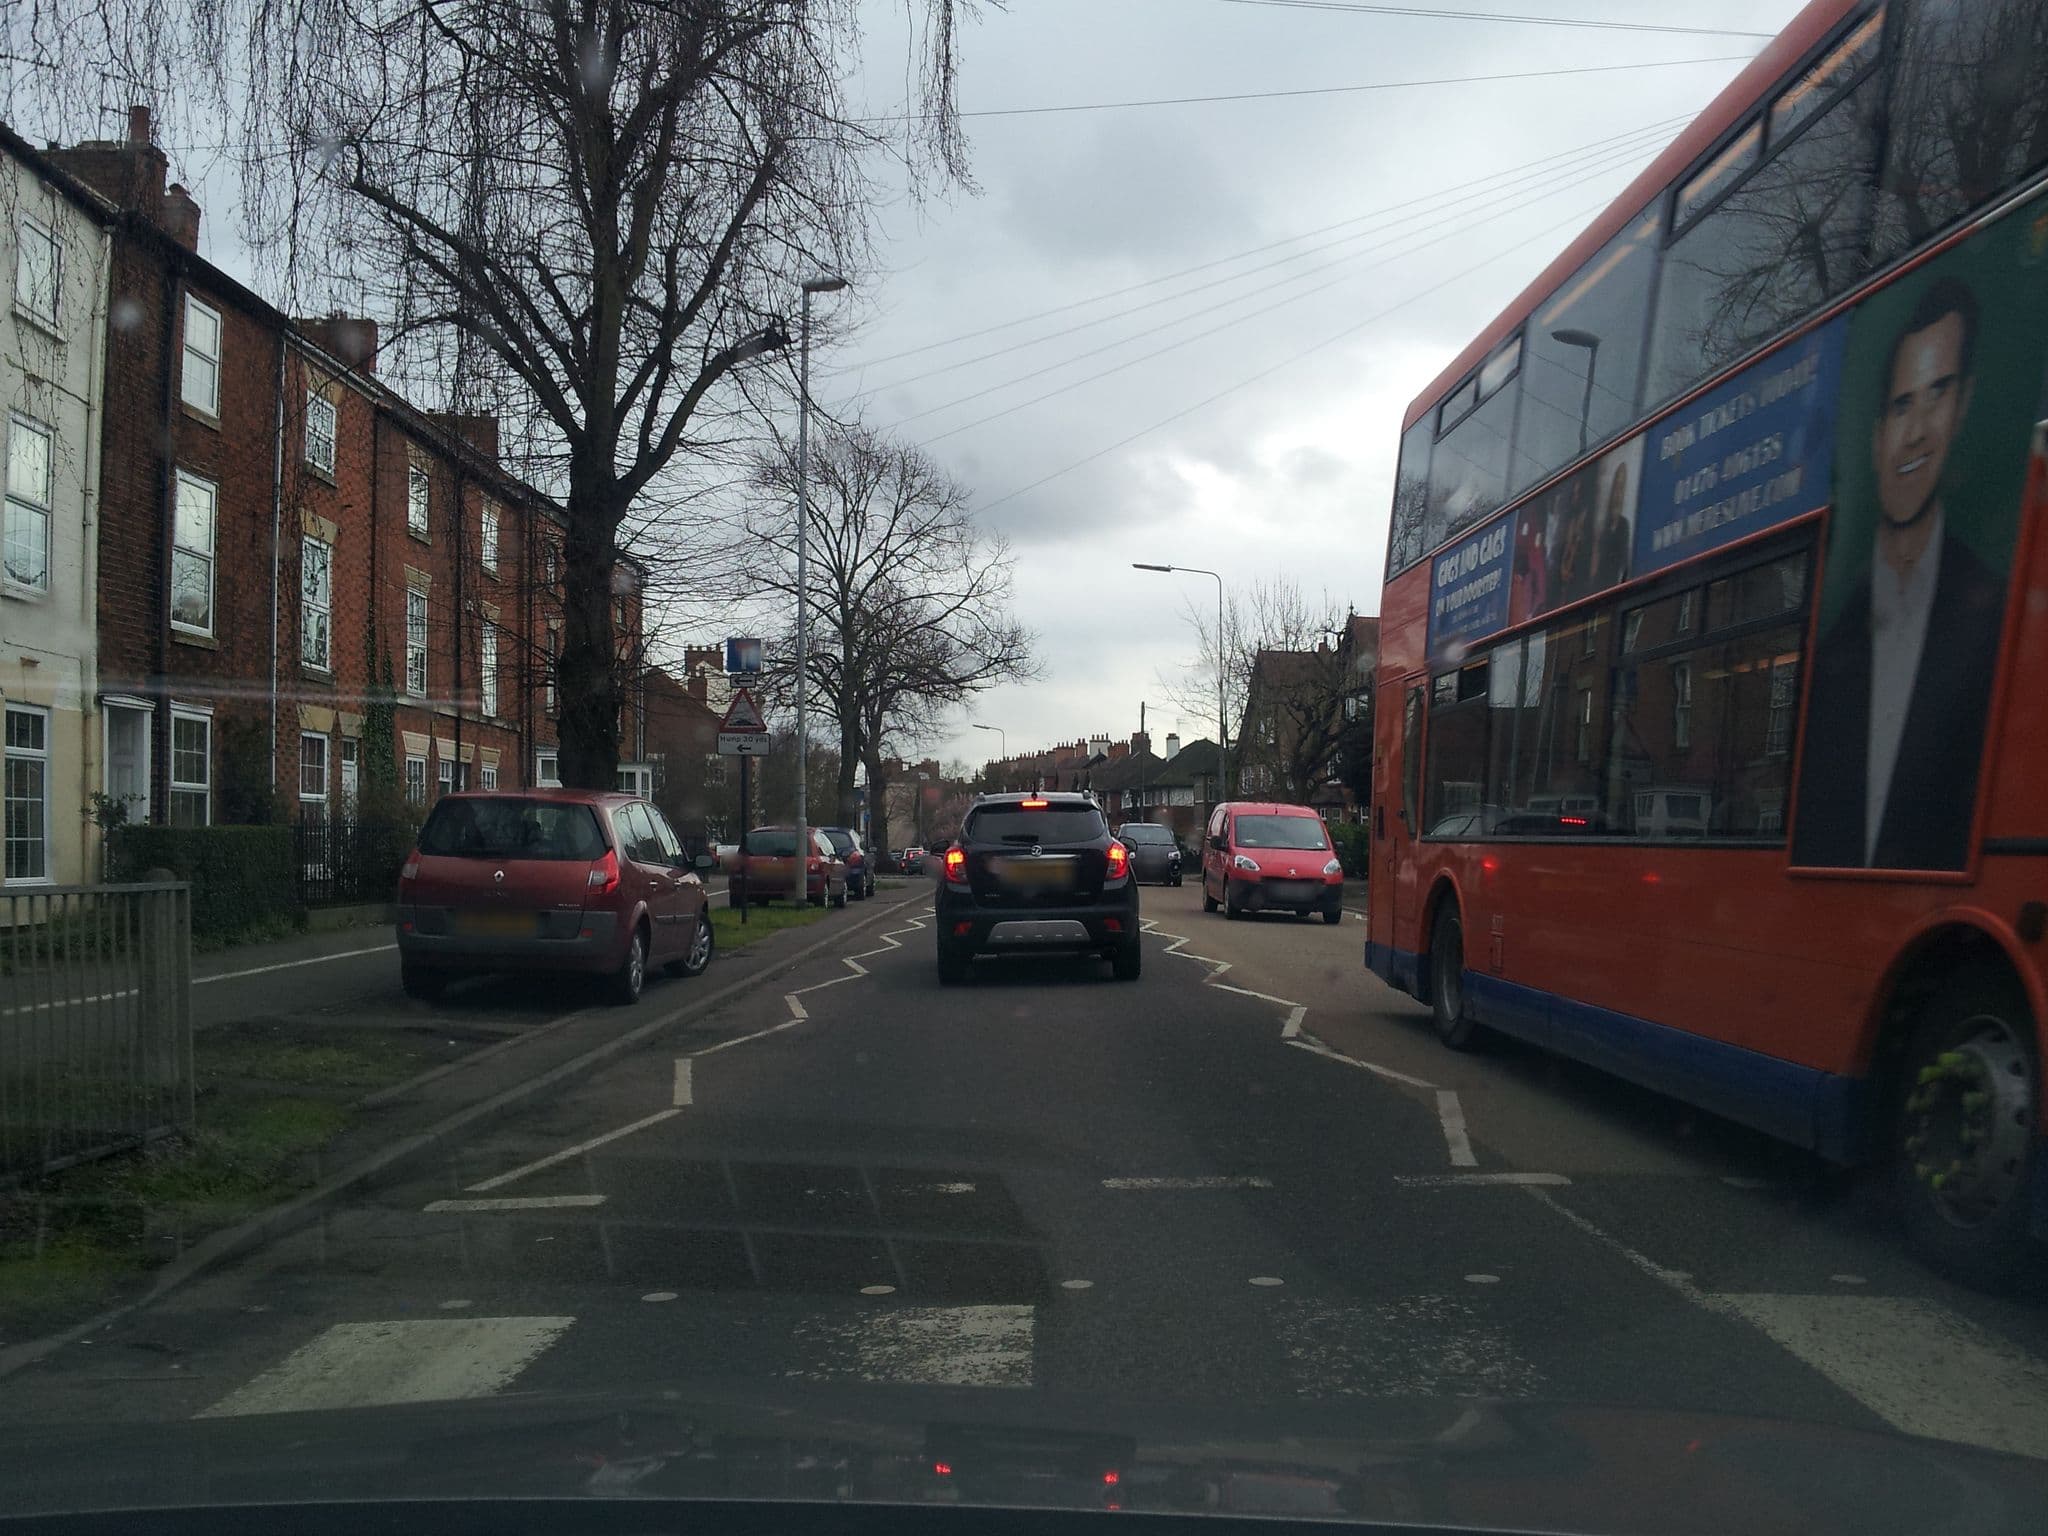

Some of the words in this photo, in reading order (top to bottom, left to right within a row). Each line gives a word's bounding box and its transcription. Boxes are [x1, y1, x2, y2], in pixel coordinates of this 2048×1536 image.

[1660, 423, 1696, 461] BOOK
[1700, 391, 1756, 440] TICKETS
[1438, 552, 1460, 588] GIGS
[1460, 542, 1479, 577] AND
[1480, 524, 1507, 565] GAGS
